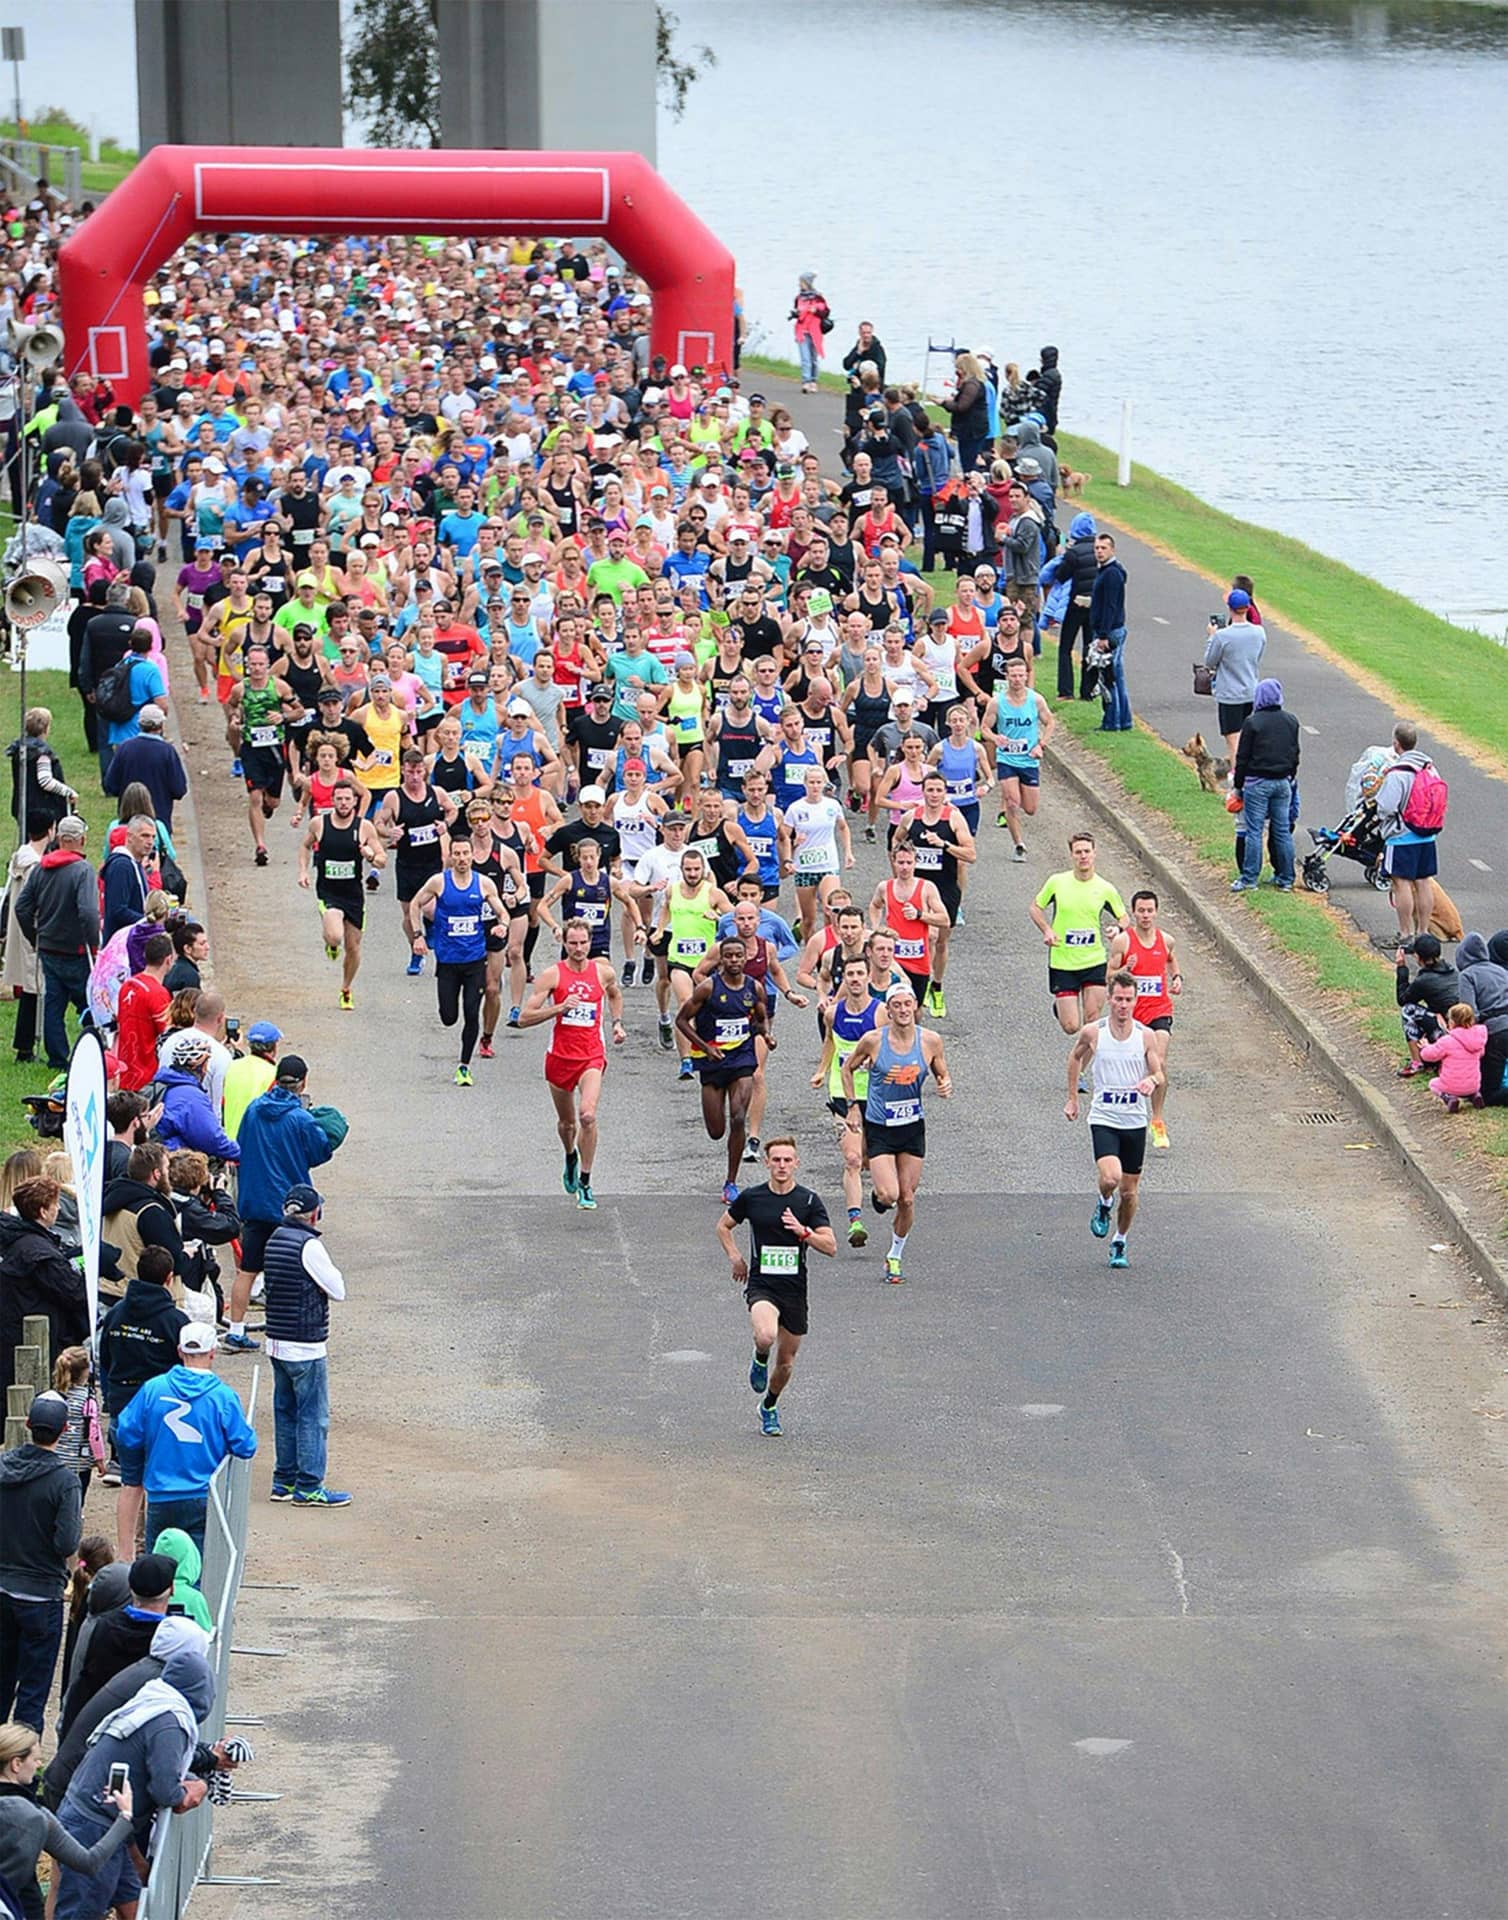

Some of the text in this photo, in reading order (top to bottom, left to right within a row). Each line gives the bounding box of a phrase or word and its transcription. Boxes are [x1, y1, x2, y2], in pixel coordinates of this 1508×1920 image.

[10, 610, 46, 627] SOUND
[1005, 718, 1031, 728] FILA
[916, 854, 938, 865] 370
[584, 908, 600, 920] 20
[1069, 934, 1090, 944] 477
[570, 1008, 591, 1019] 425
[720, 1025, 742, 1038] 291
[894, 1104, 914, 1119] 749
[764, 1253, 796, 1266] 1119
